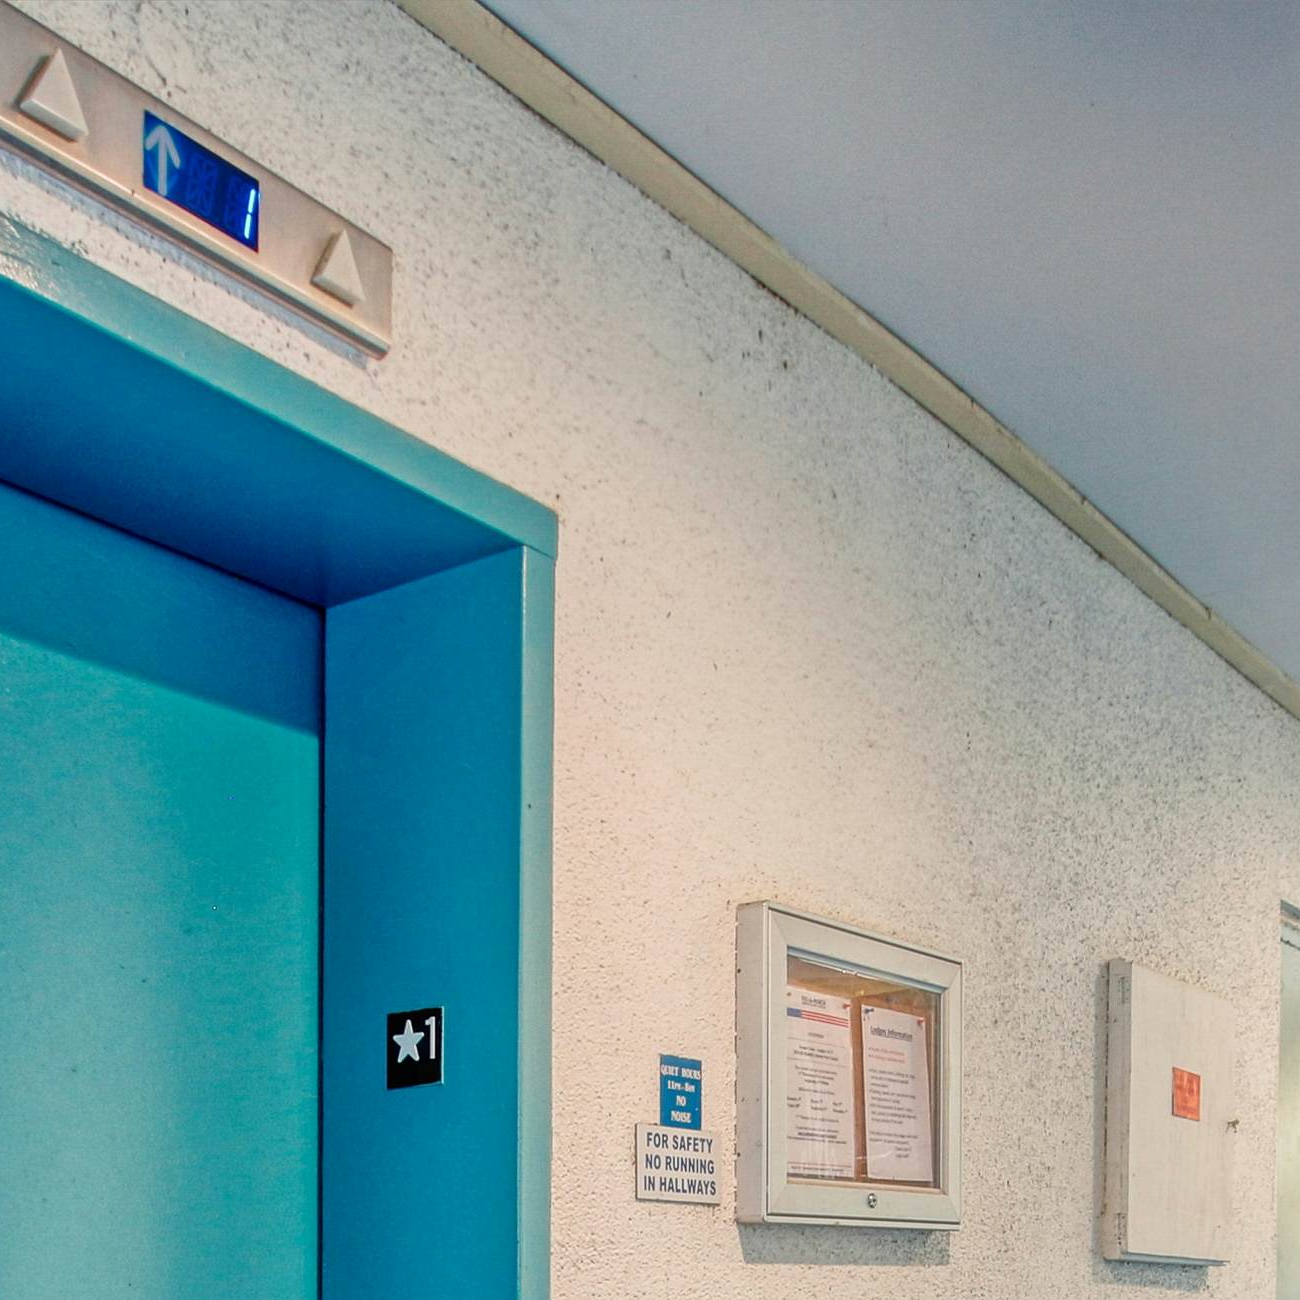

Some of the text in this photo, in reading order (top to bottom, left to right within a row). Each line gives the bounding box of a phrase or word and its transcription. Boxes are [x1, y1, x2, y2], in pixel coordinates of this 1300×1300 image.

[424, 1015, 436, 1059] 1
[675, 1095, 687, 1107] NO
[670, 1110, 692, 1124] NOISE
[646, 1132, 713, 1154] FOR SAFETY
[645, 1153, 715, 1175] NO RUNNING
[643, 1175, 717, 1196] IN HALLWAYS
